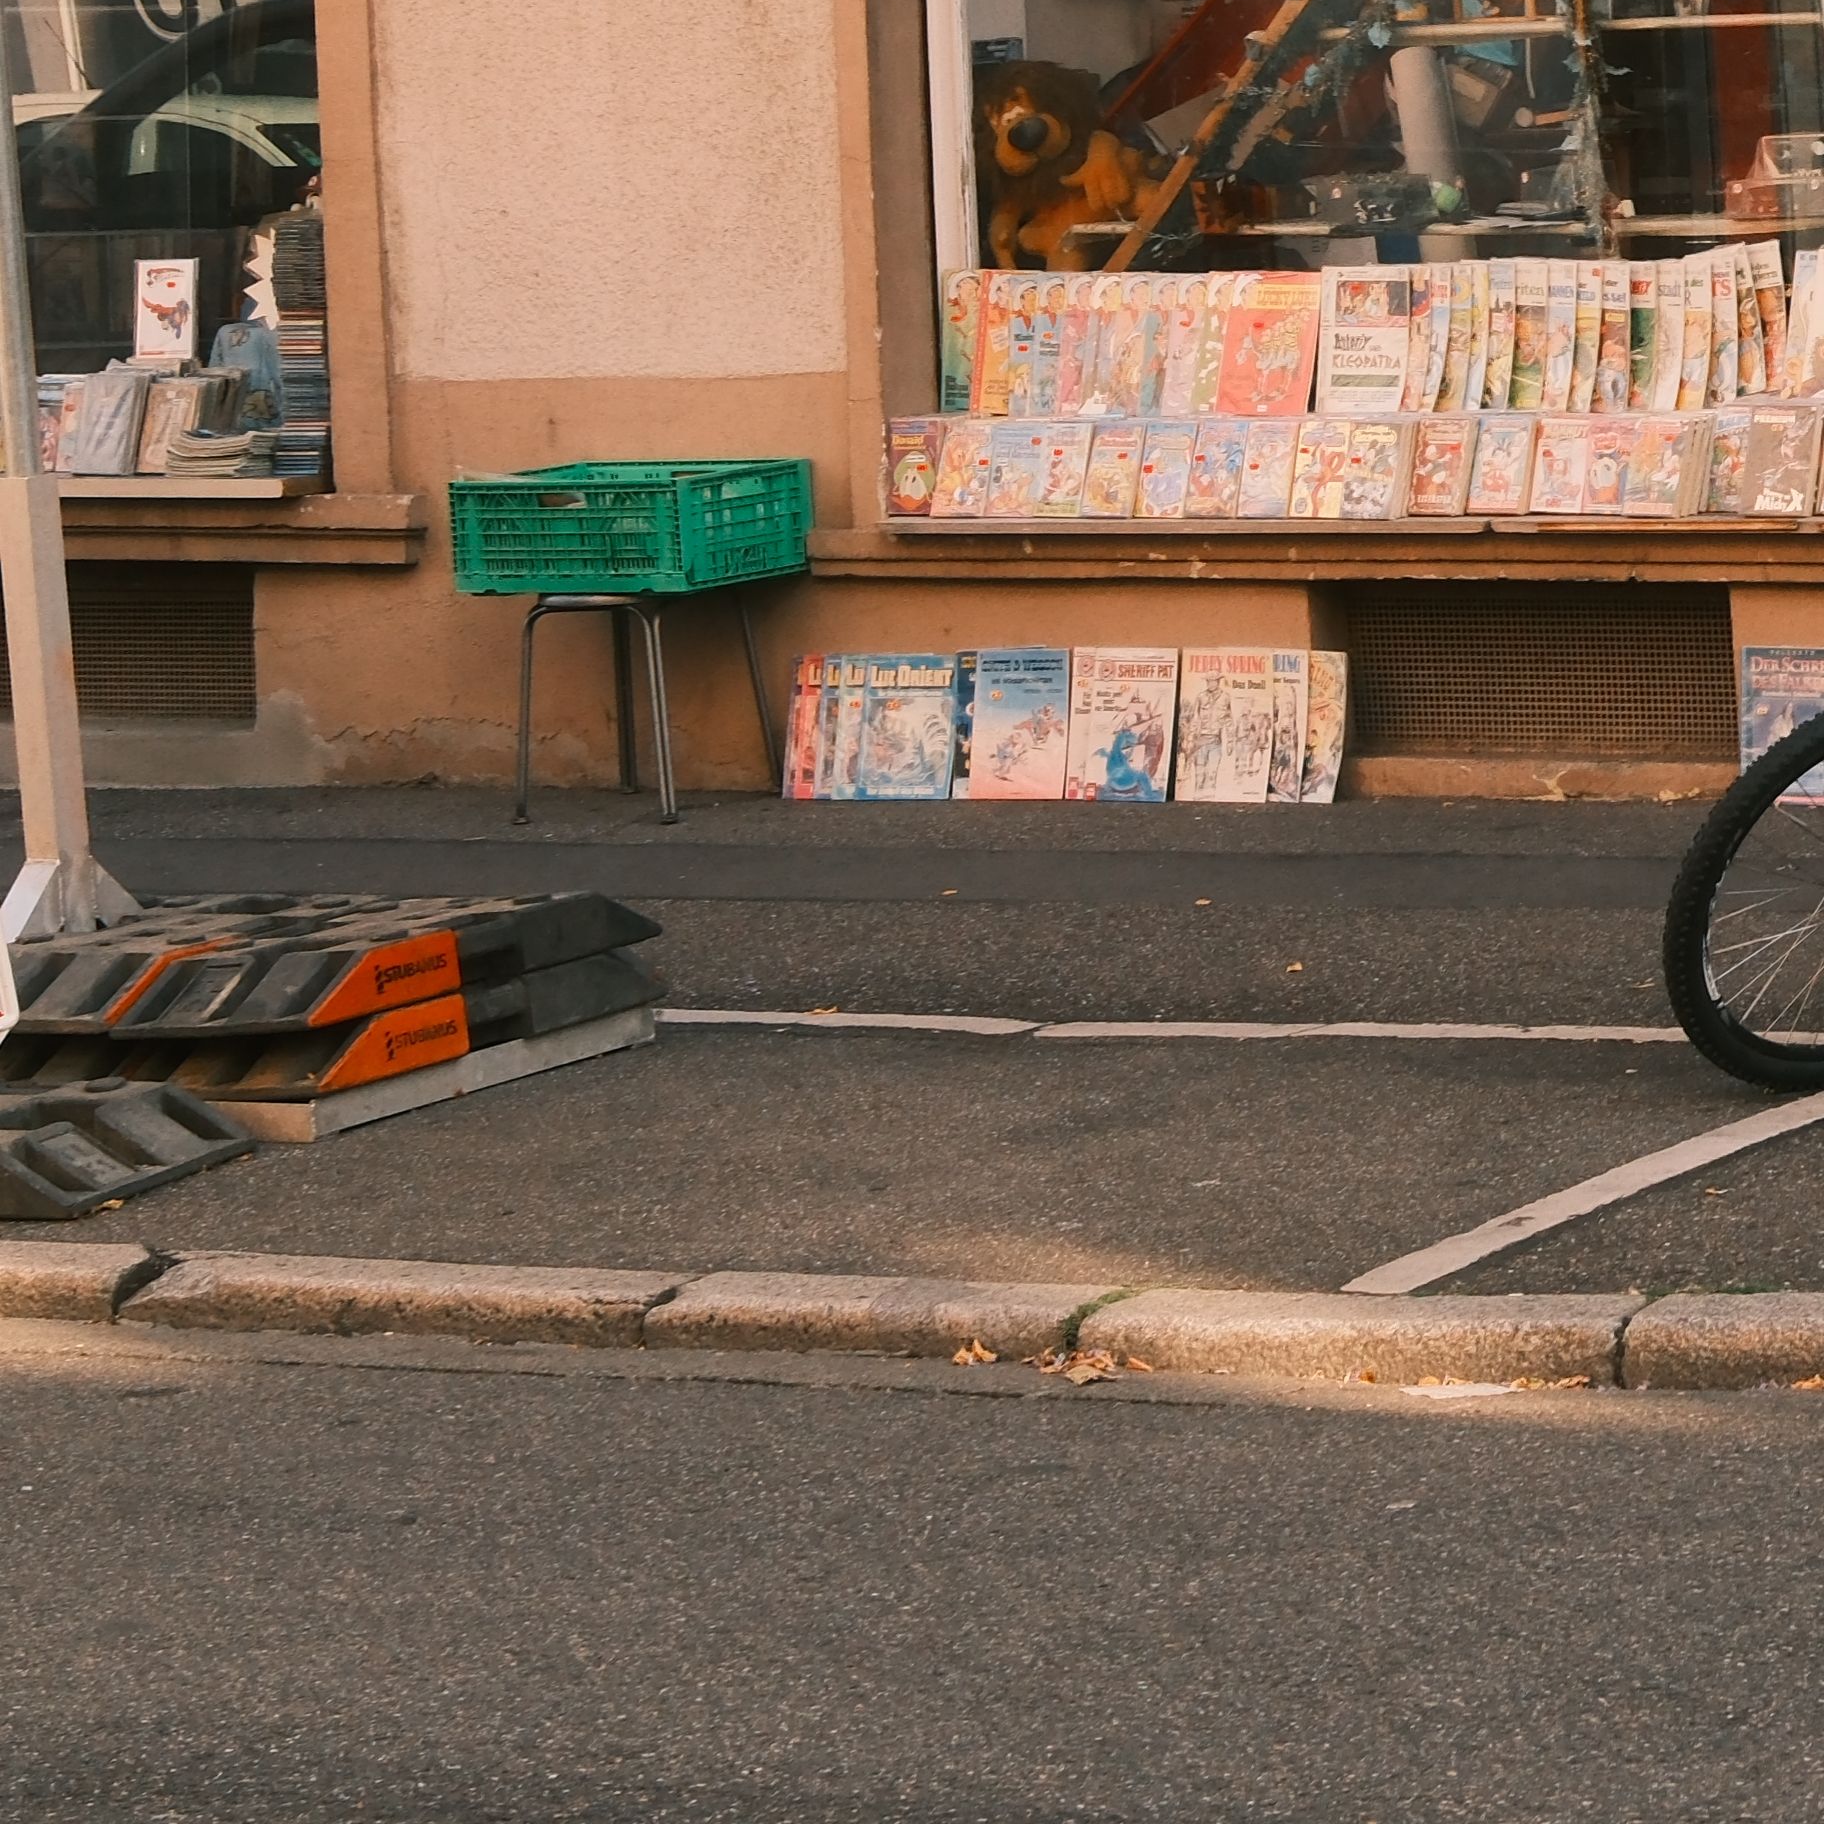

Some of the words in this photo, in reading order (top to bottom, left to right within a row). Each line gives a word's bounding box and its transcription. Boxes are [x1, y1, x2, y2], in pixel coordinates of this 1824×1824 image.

[1118, 664, 1156, 678] SHERIFF
[1158, 664, 1174, 679] PAT
[1189, 655, 1222, 673] JERRY
[1226, 655, 1266, 674] SPRING
